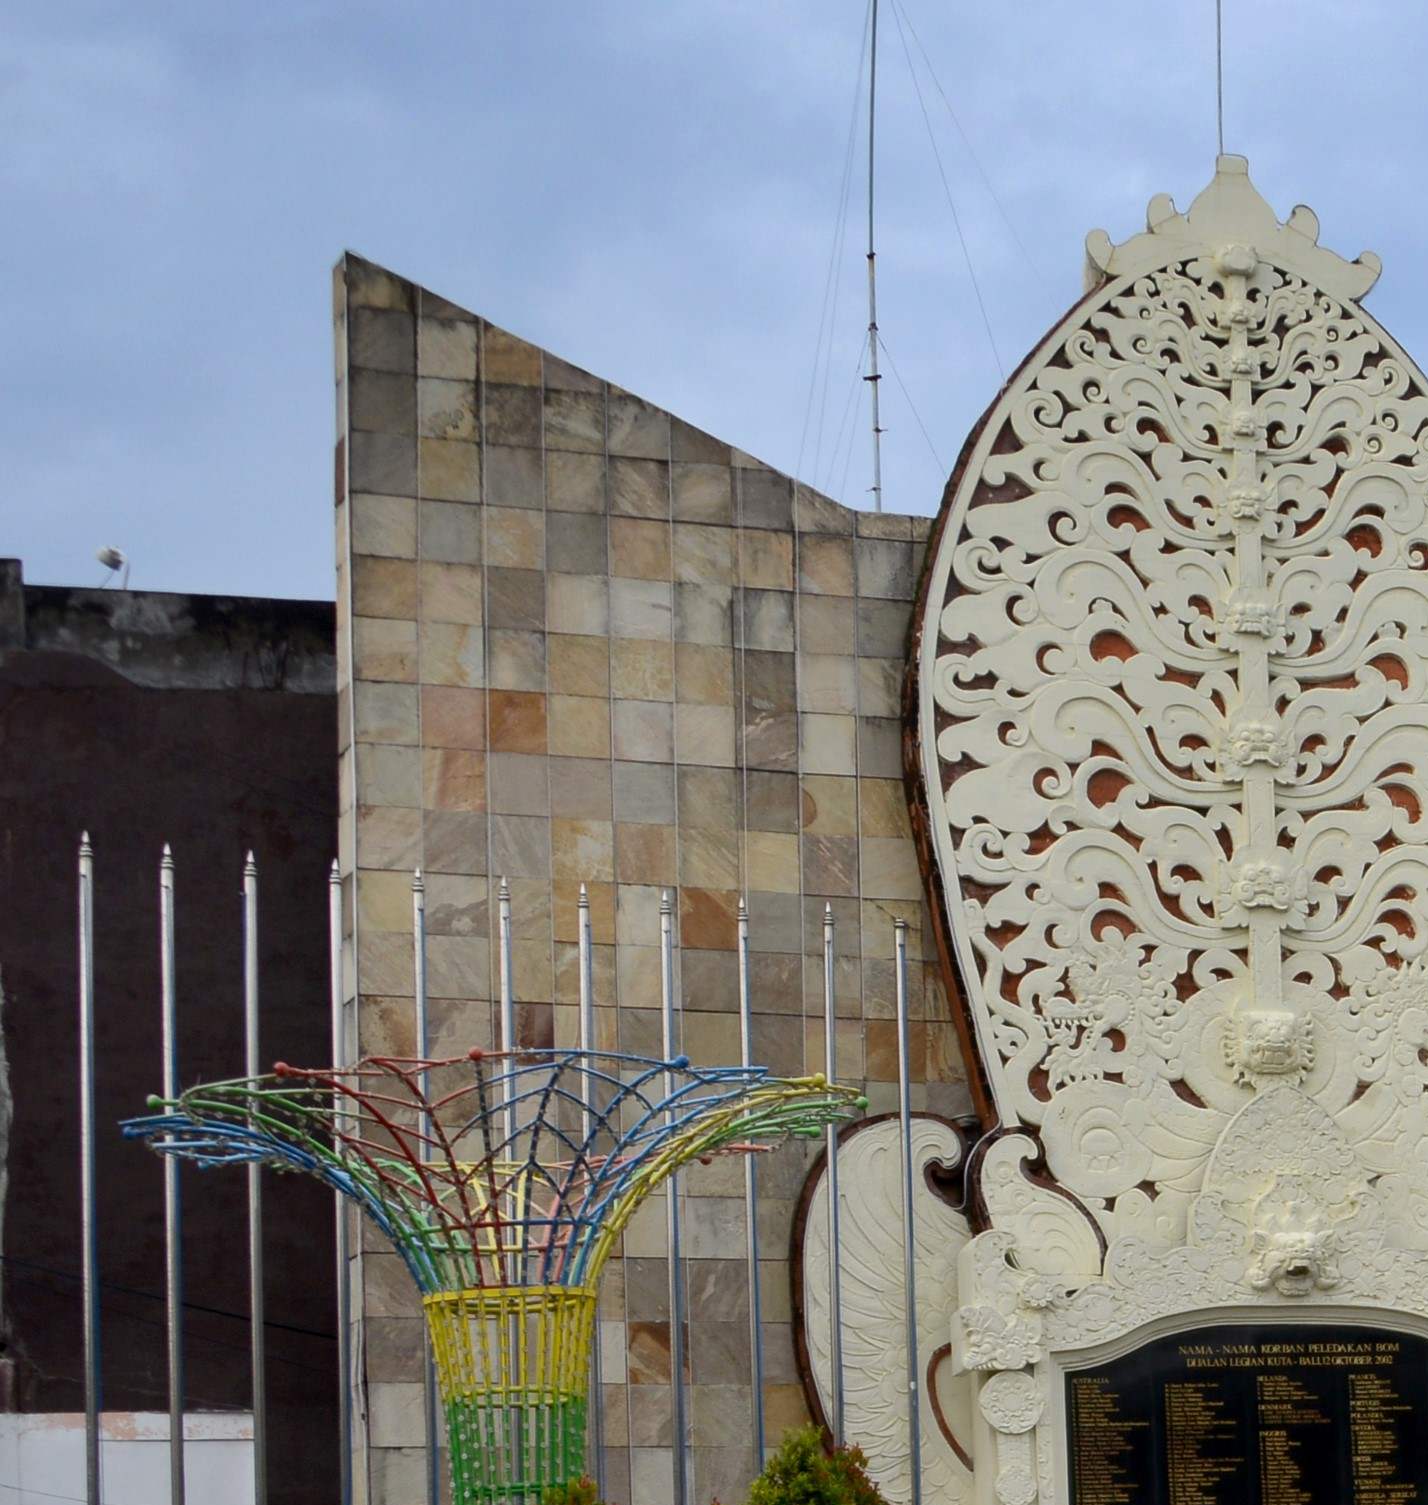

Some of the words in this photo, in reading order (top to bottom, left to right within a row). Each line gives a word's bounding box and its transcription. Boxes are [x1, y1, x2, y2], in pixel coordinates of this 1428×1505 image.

[1178, 1345, 1213, 1355] NAMA
[1222, 1344, 1257, 1354] NAMA
[1261, 1343, 1305, 1354] KORBAN
[1308, 1343, 1372, 1353] PELEDAKAN
[1375, 1342, 1400, 1352] BOM
[1230, 1356, 1265, 1366] LEGIAN
[1267, 1356, 1292, 1366] KUTA
